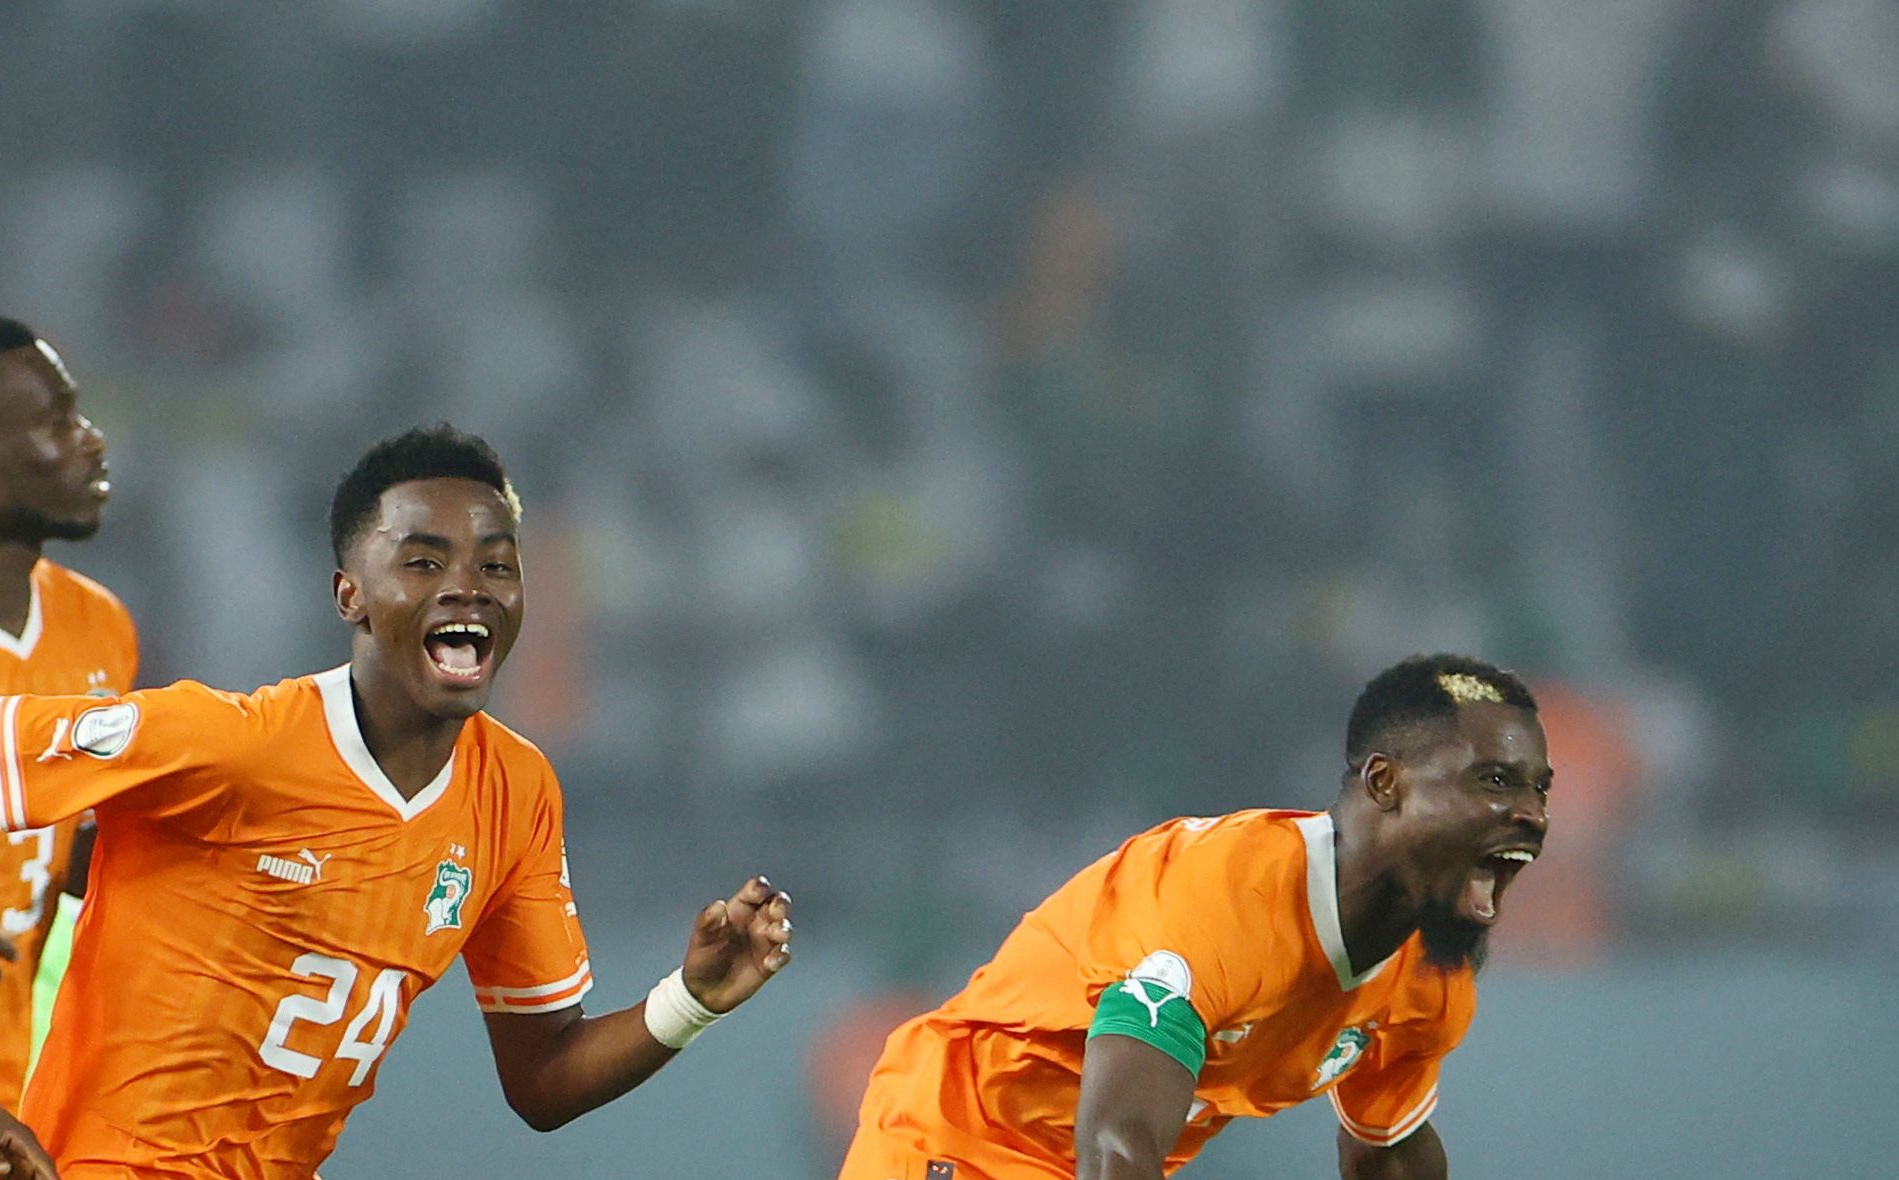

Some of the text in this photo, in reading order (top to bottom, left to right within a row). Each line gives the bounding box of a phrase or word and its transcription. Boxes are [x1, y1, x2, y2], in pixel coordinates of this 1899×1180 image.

[1, 824, 56, 934] 3
[256, 853, 314, 886] PUMA
[257, 951, 408, 1087] 24
